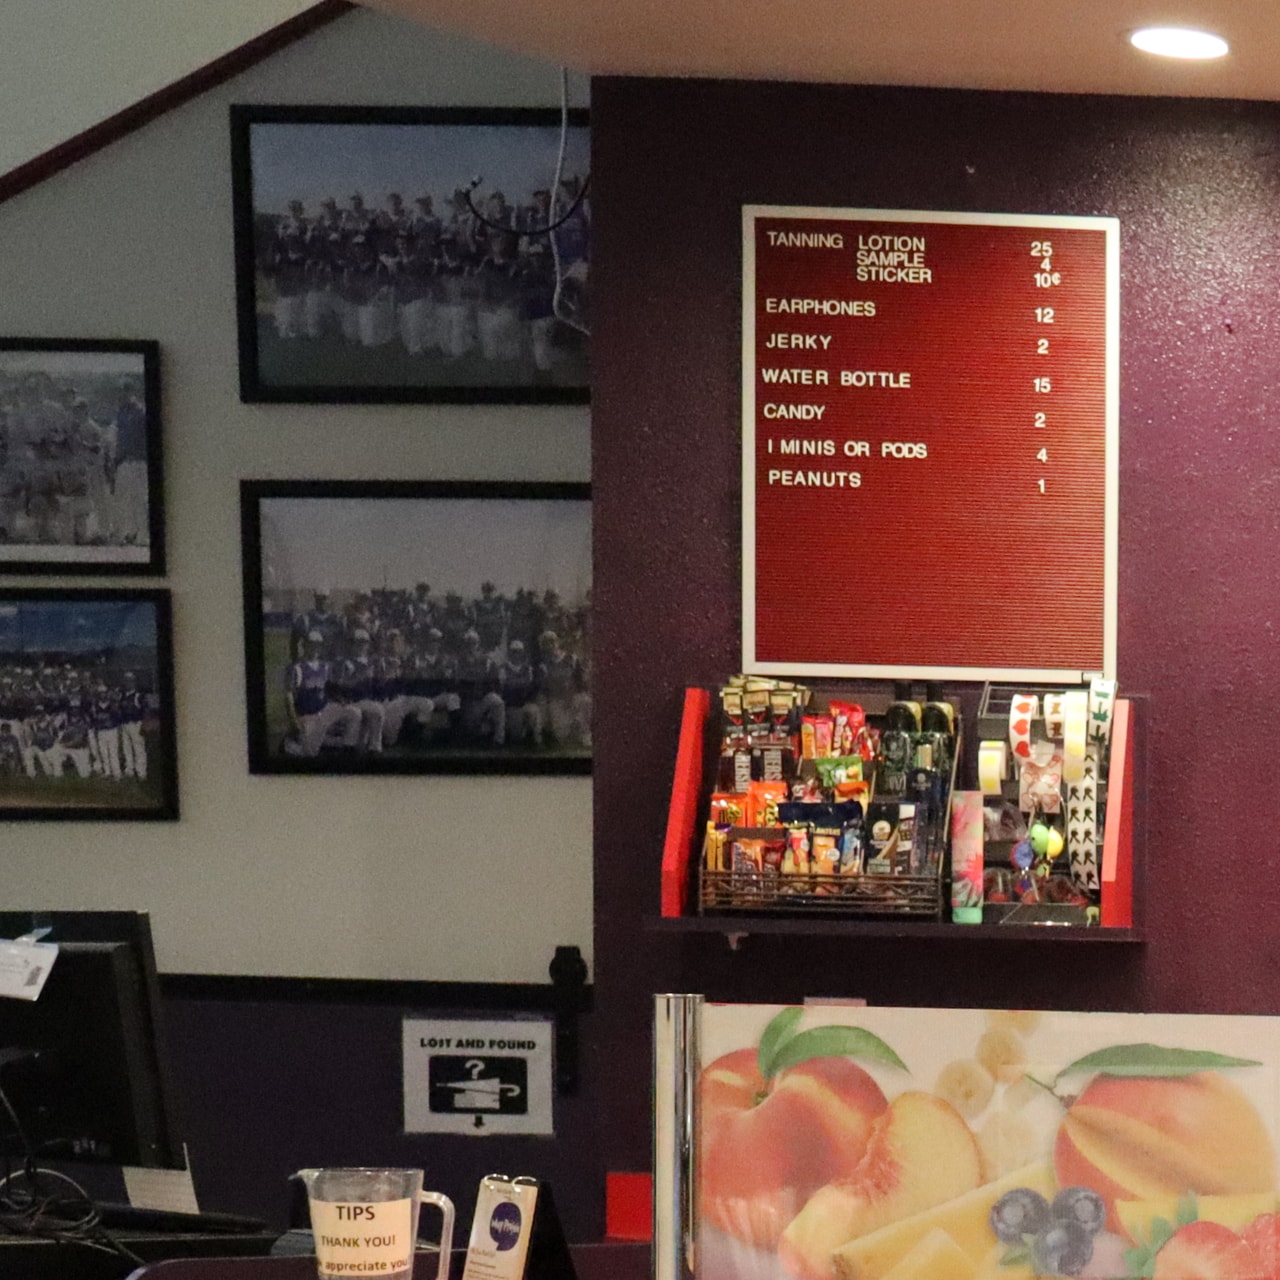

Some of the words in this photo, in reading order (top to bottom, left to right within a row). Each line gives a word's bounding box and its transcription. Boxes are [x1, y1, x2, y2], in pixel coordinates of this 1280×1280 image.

[767, 231, 843, 249] TANNING
[859, 235, 925, 252] LOTION
[1031, 242, 1052, 257] 25
[857, 252, 925, 268] SAMPLE
[1041, 258, 1051, 271] 4
[856, 267, 932, 283] STICKER
[1034, 273, 1061, 288] 10¢
[766, 299, 875, 317] EARPHONES
[1035, 309, 1054, 323] 12
[766, 335, 832, 349] JERKY
[1037, 340, 1048, 354] 2
[762, 369, 829, 385] WATER
[841, 372, 911, 388] BOTTLE
[1033, 378, 1050, 392] 15
[764, 404, 825, 420] CANDY
[1035, 413, 1045, 427] 2
[780, 440, 835, 456] MINIS
[844, 442, 870, 457] OR
[881, 443, 927, 458] PODS
[1036, 449, 1047, 462] 4
[768, 471, 861, 488] PEANUTS
[1038, 479, 1045, 493] 1
[420, 1038, 451, 1048] LOST
[456, 1039, 485, 1049] AND
[489, 1040, 536, 1050] FOUND
[336, 1205, 376, 1221] TIPS
[321, 1236, 360, 1248] THANK
[364, 1234, 396, 1248] YOU!
[325, 1261, 387, 1272] appreciate
